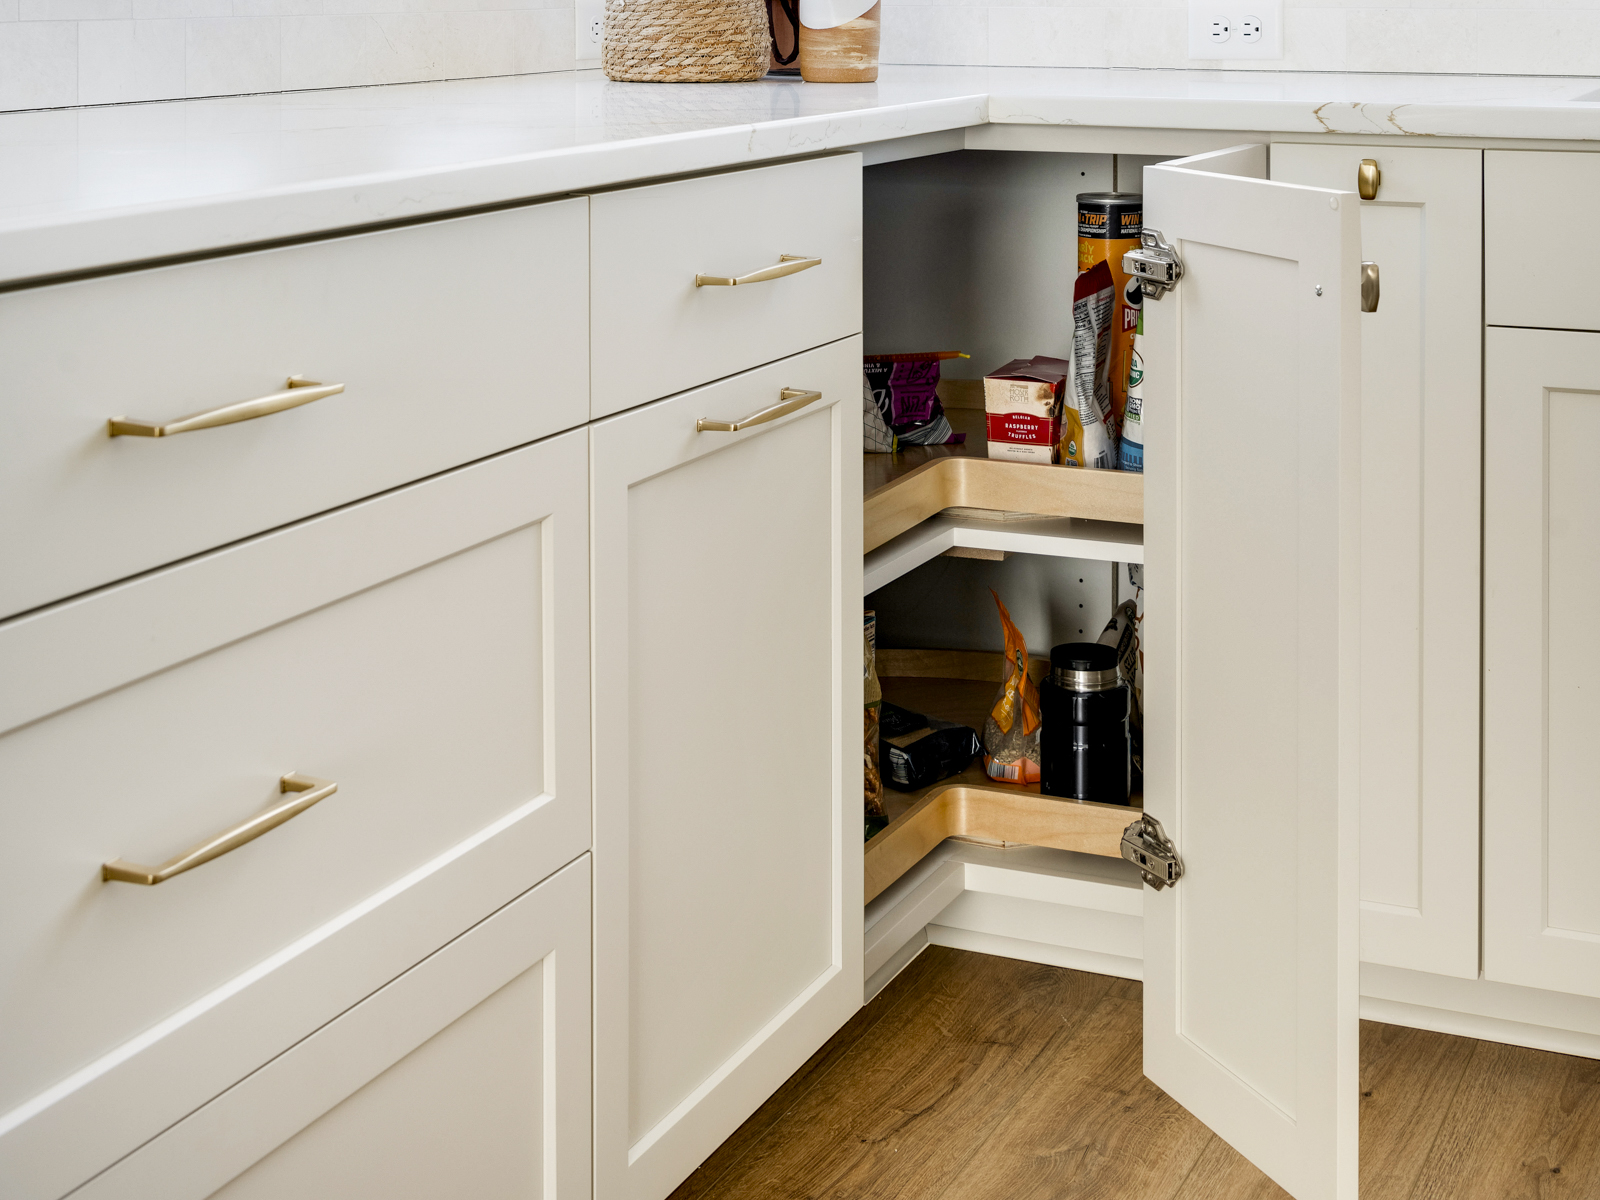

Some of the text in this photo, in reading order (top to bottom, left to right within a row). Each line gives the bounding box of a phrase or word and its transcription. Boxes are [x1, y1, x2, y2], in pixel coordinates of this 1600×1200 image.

[1085, 214, 1107, 225] TRIP
[1121, 214, 1140, 225] WIN
[1010, 395, 1029, 403] ROTH
